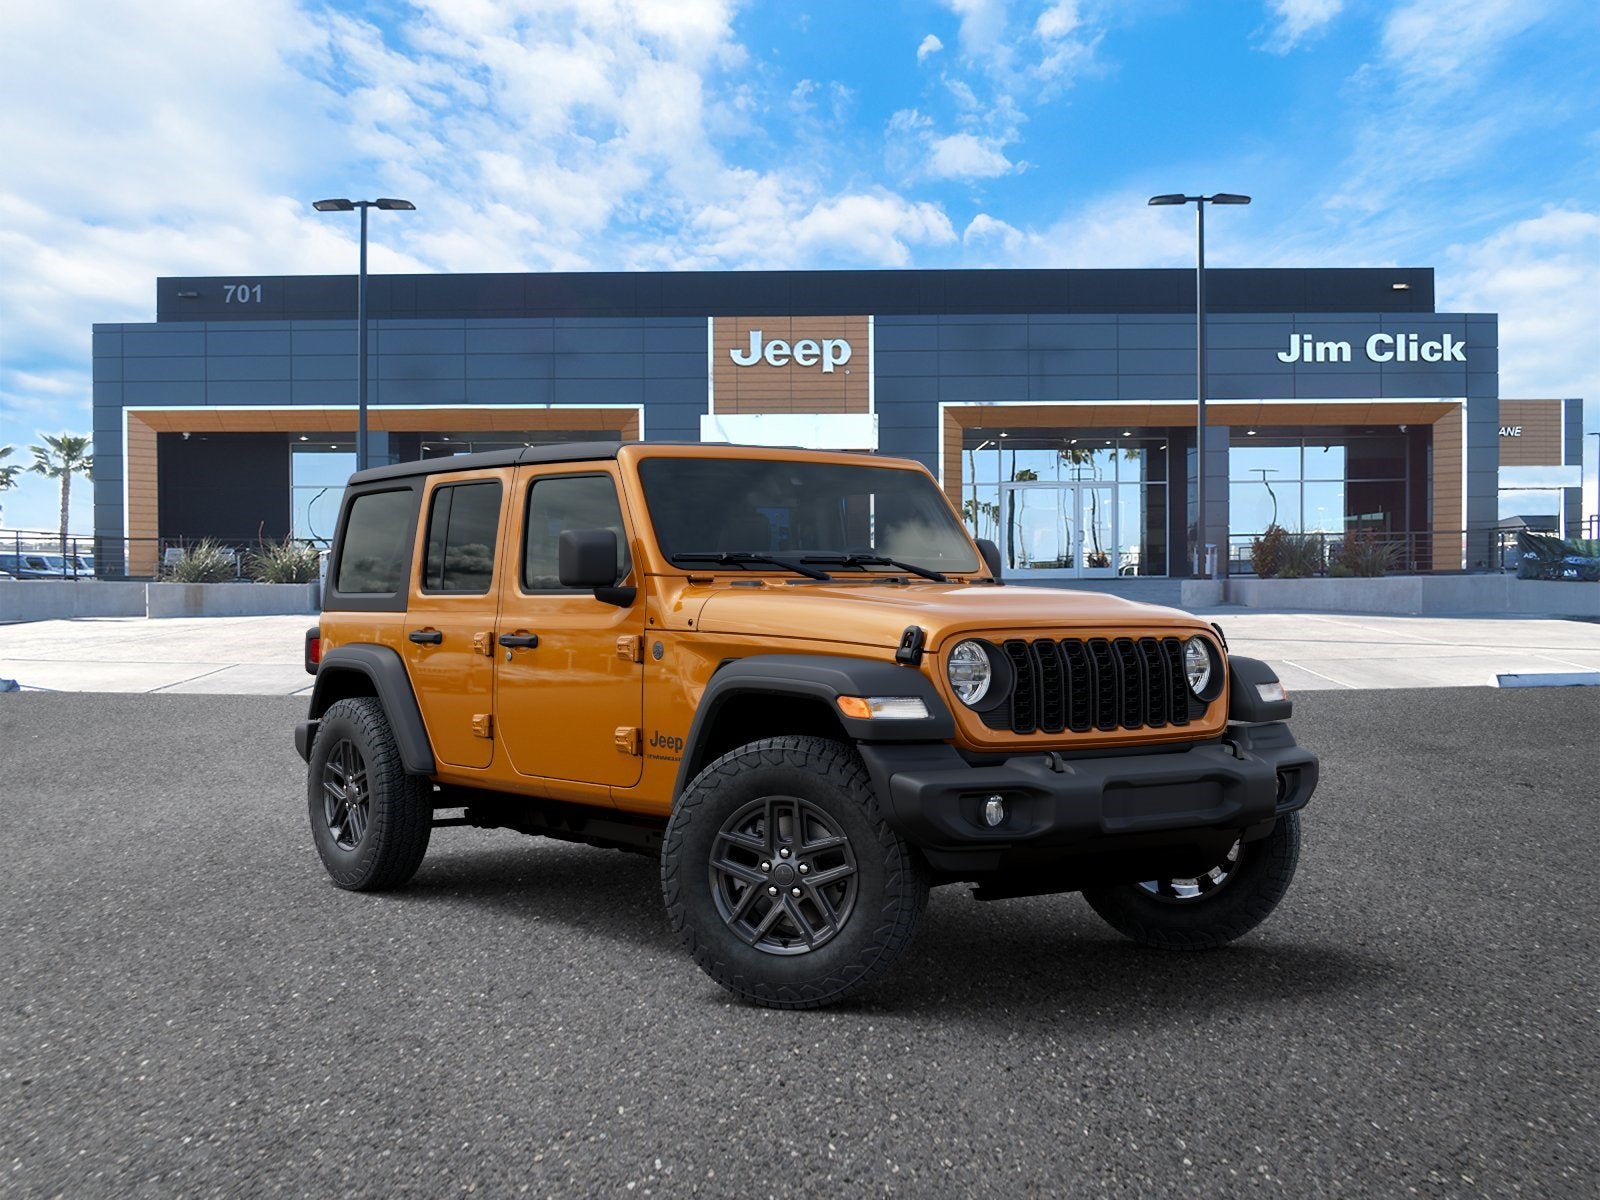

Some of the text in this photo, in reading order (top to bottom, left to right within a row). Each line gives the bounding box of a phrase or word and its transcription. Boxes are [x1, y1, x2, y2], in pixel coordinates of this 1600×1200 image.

[223, 284, 262, 304] 701
[729, 330, 852, 373] Jeep
[1277, 333, 1467, 363] Jim Click
[1498, 426, 1522, 437] ANE
[649, 730, 684, 754] Jeep
